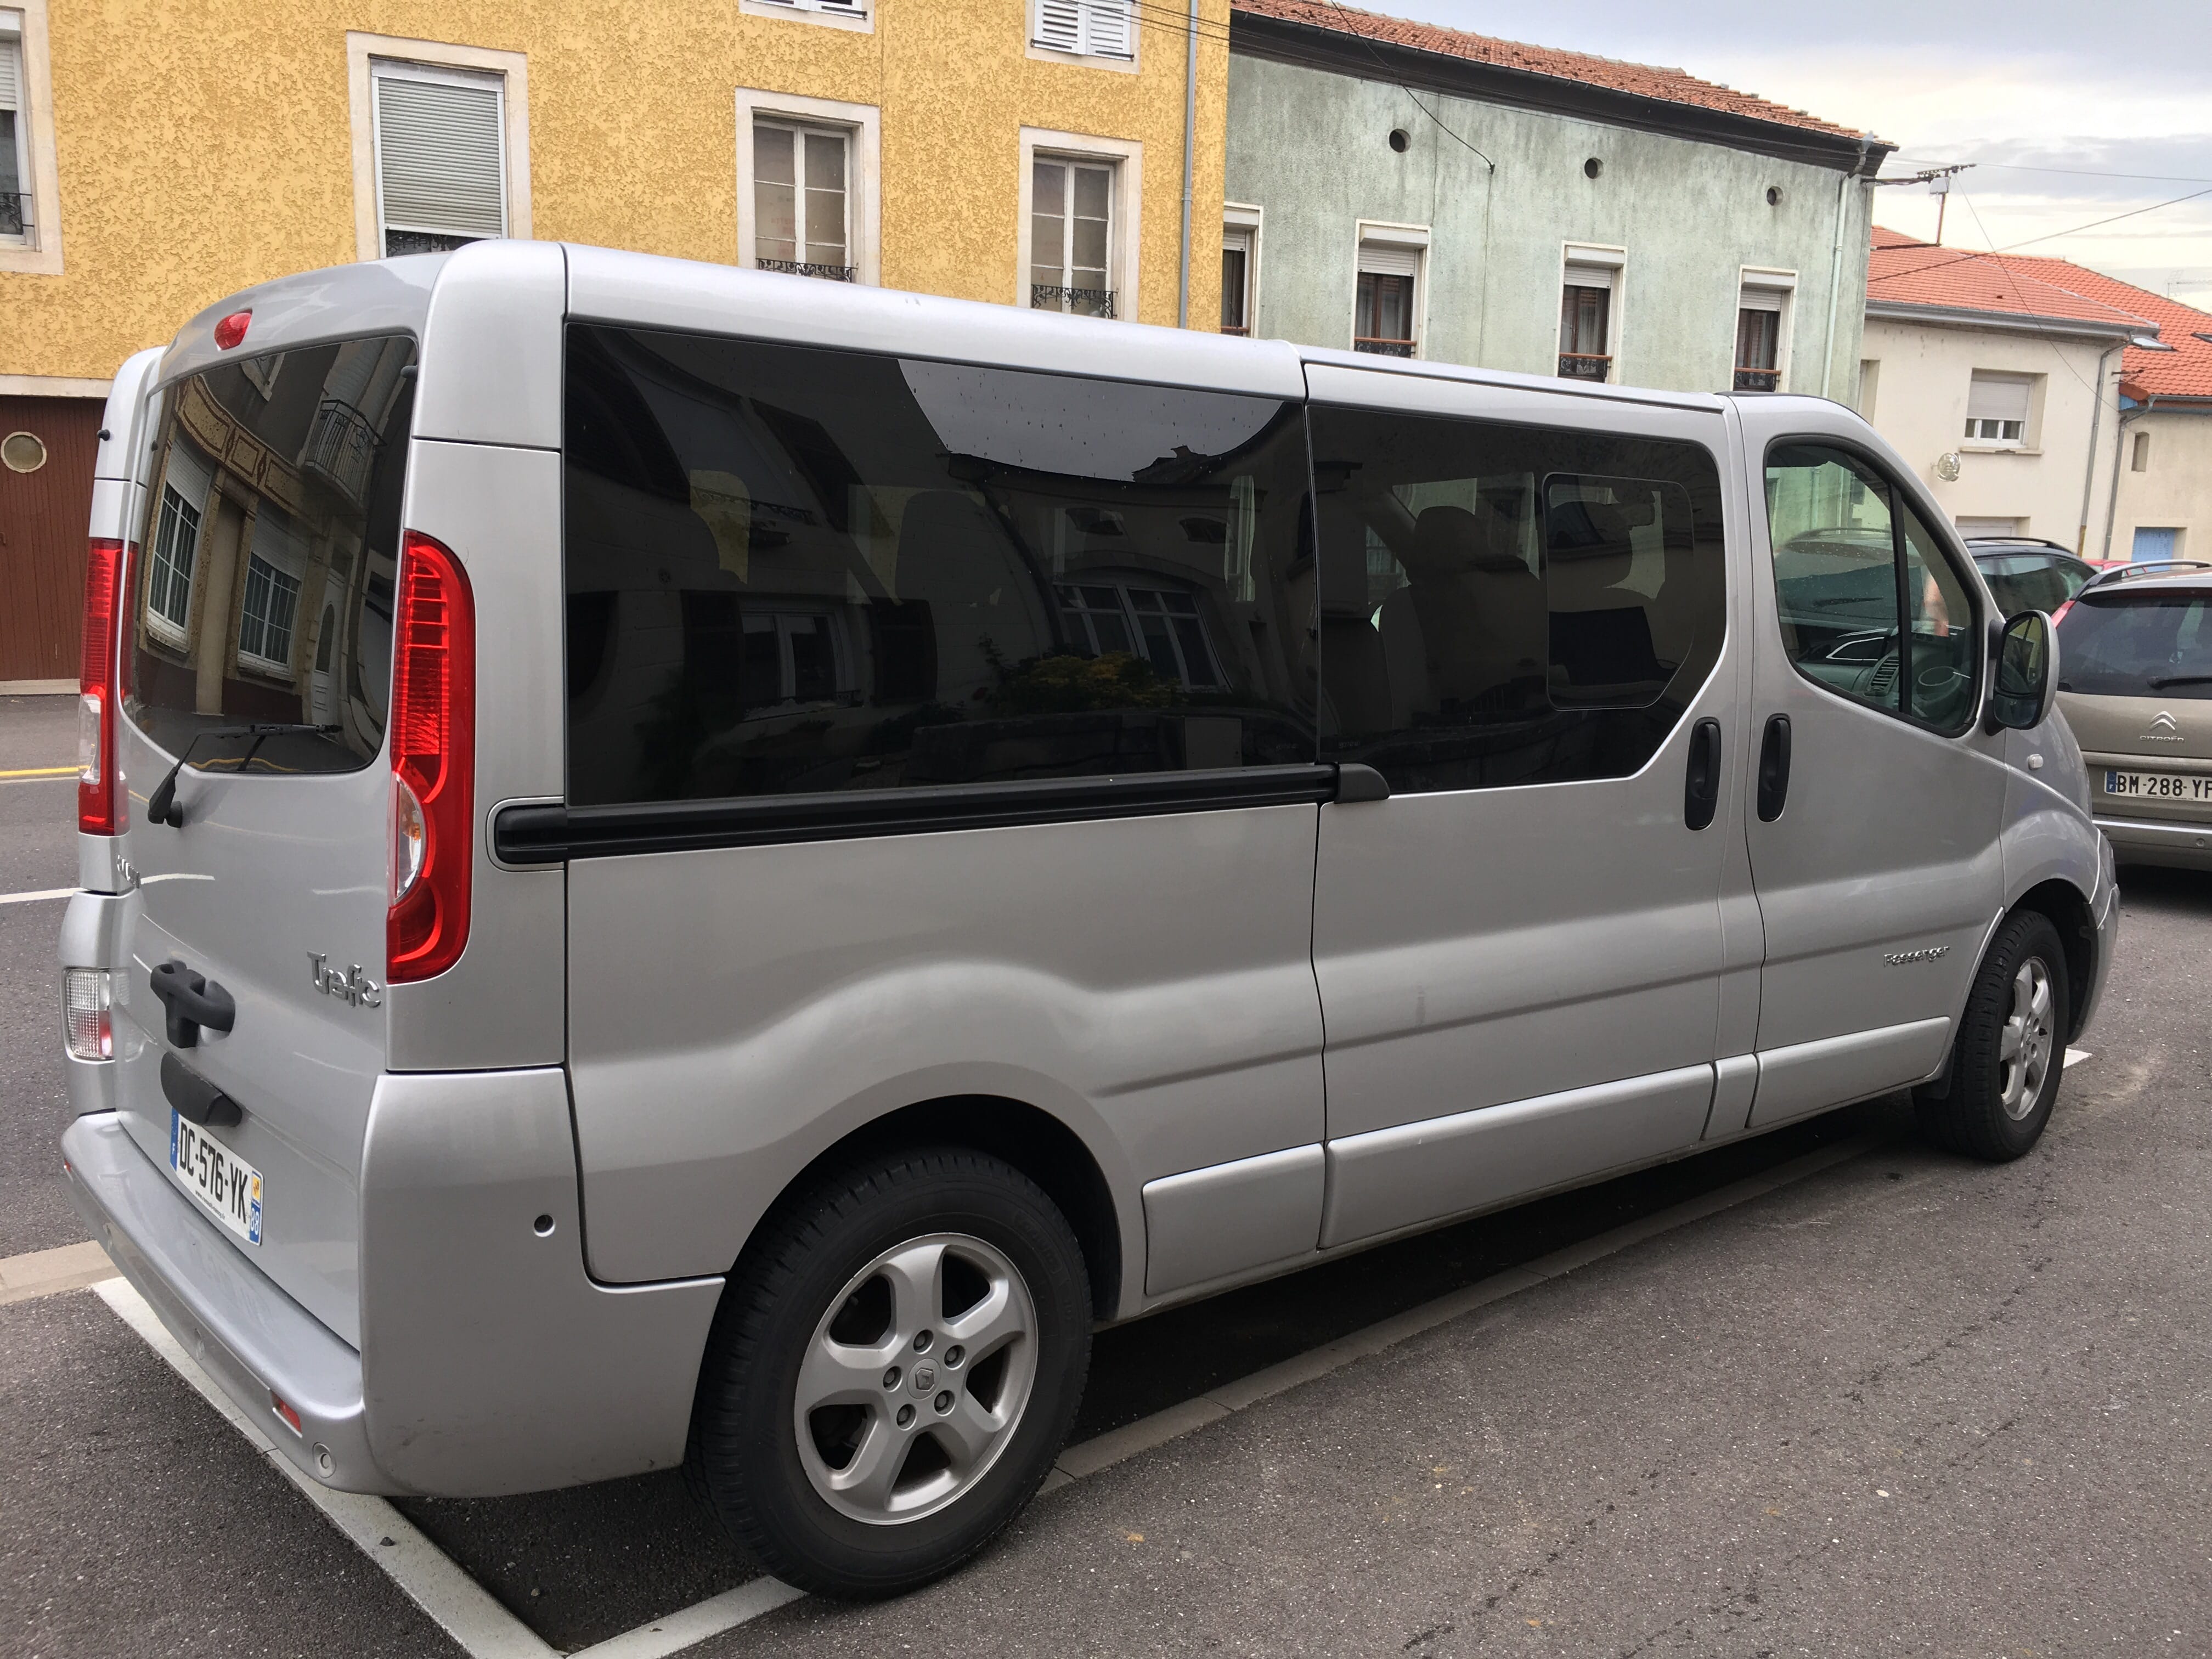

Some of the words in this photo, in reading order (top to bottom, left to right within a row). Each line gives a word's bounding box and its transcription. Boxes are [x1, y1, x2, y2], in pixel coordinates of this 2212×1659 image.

[307, 950, 381, 1008] Trafic
[179, 1121, 248, 1224] DC-576-YK
[250, 1207, 259, 1235] 88
